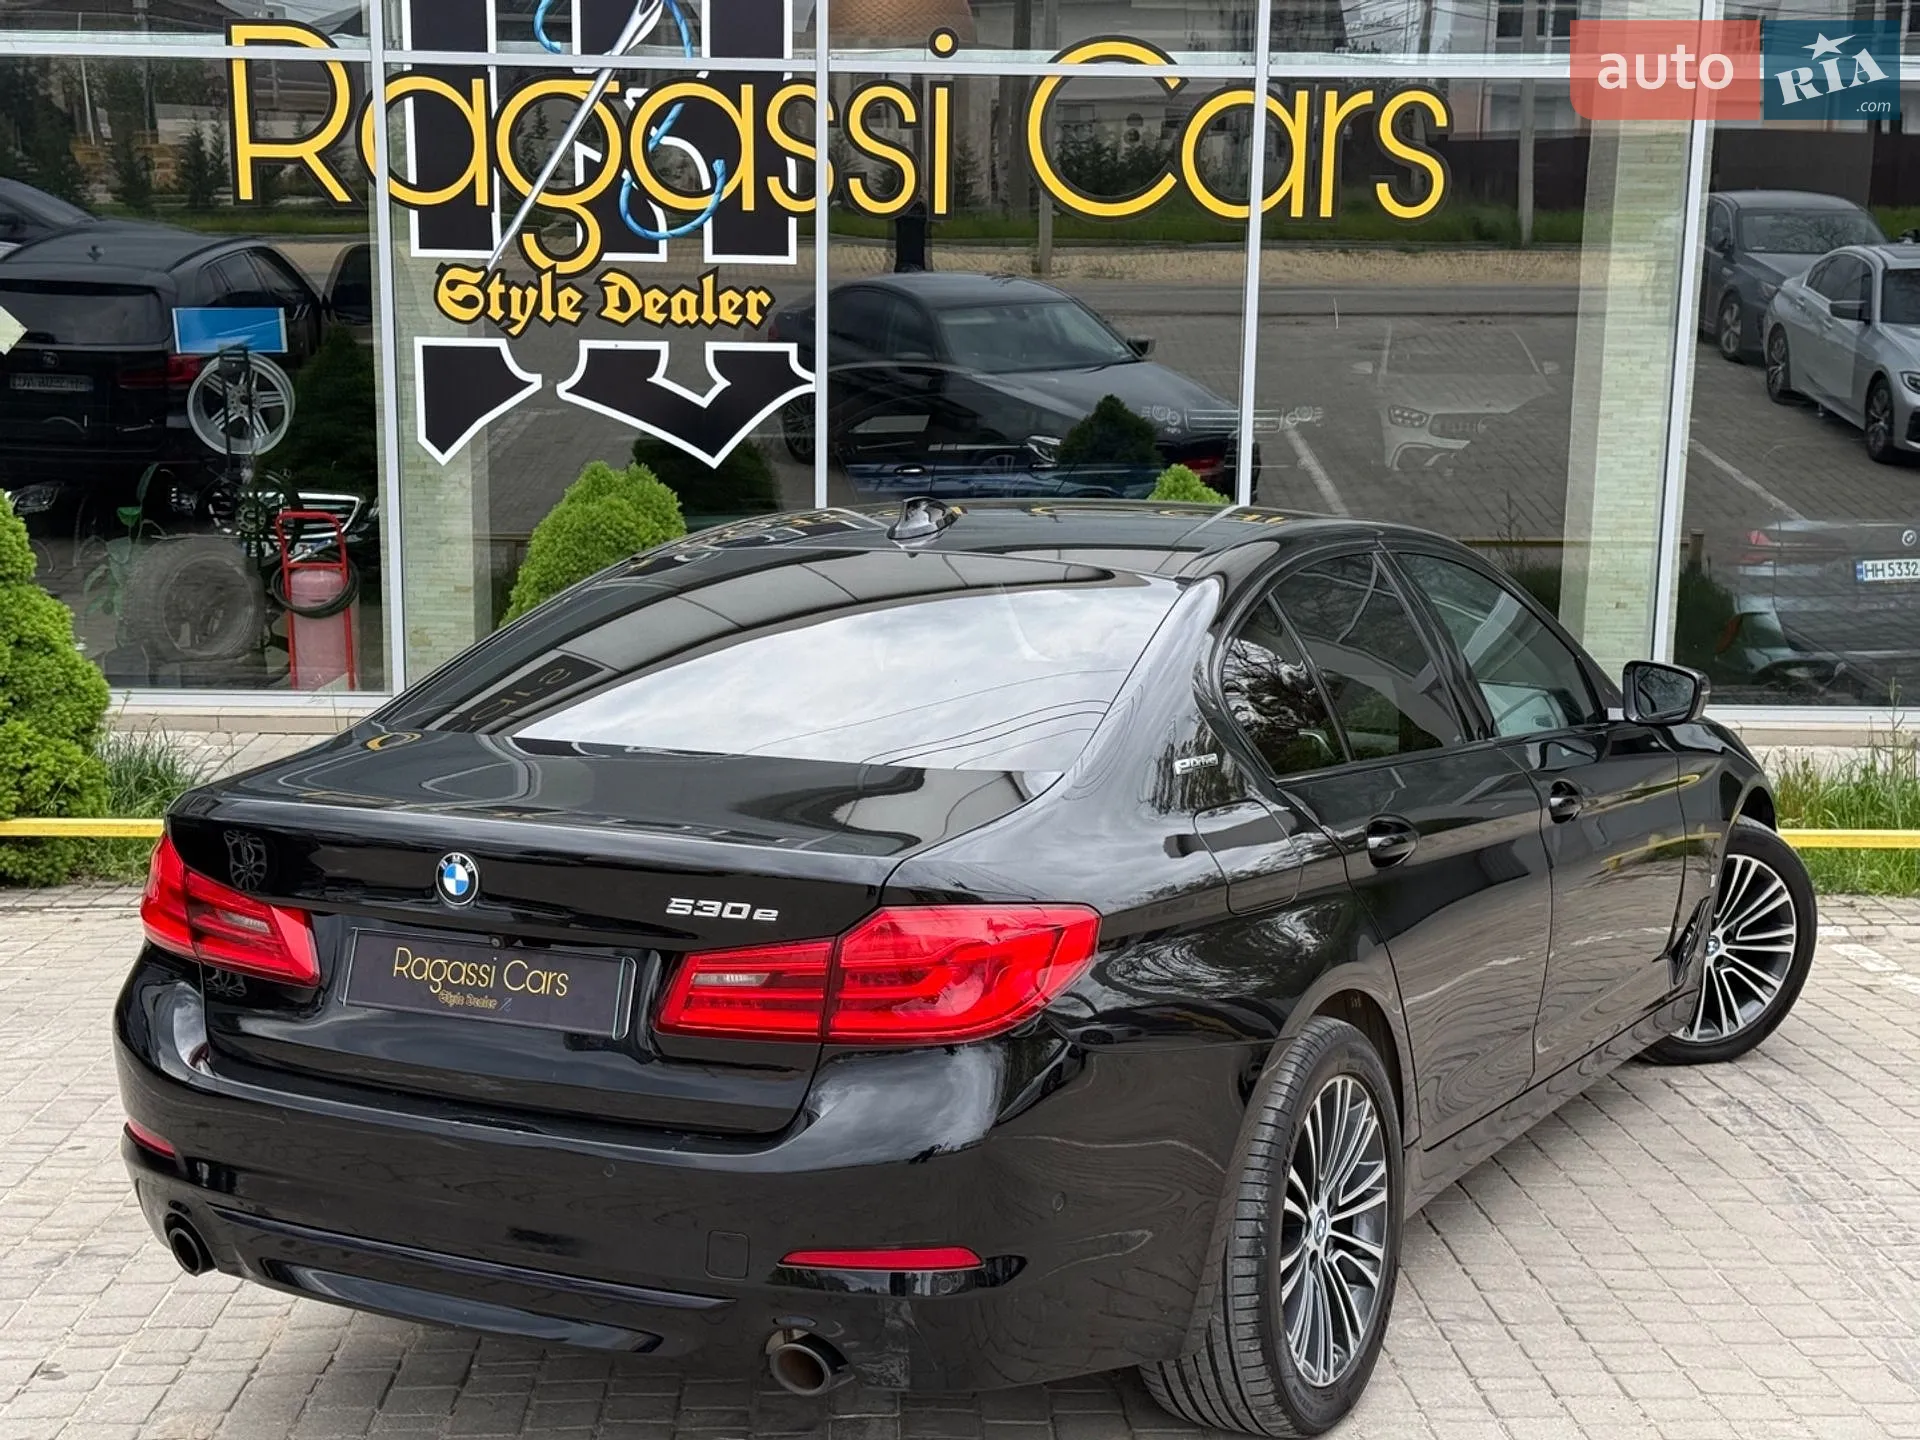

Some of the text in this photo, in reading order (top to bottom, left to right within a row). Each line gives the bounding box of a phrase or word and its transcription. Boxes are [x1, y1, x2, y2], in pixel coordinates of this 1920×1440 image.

[230, 24, 1449, 274] Ragassi Cars
[435, 266, 774, 338] Style Dealer
[393, 946, 569, 997] Ragassi Cars
